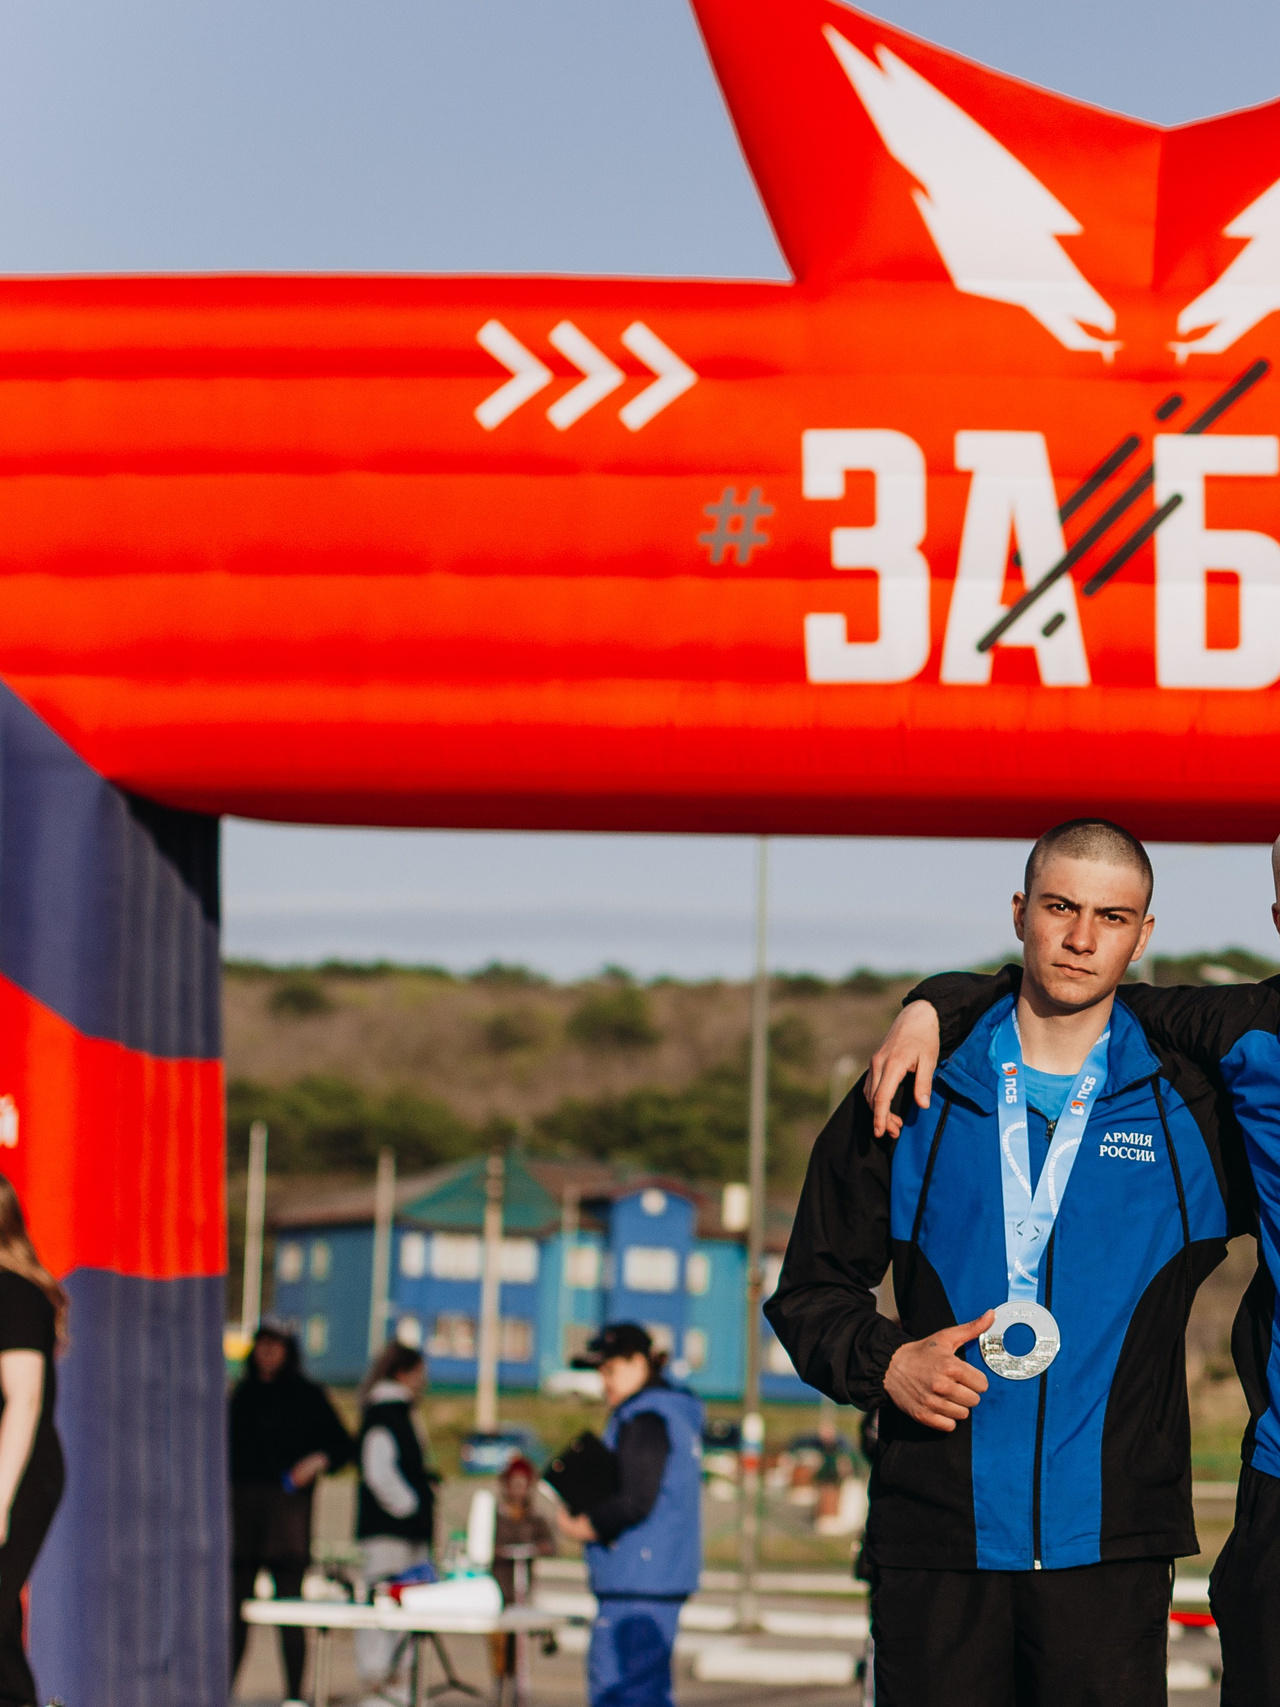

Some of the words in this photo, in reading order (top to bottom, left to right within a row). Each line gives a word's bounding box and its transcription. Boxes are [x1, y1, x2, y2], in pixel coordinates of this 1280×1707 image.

[1004, 1078, 1018, 1104] ПСБ
[1076, 1075, 1097, 1101] ПСБ
[1102, 1132, 1153, 1147] АРМИЯ
[1098, 1144, 1156, 1163] РОССИИ
